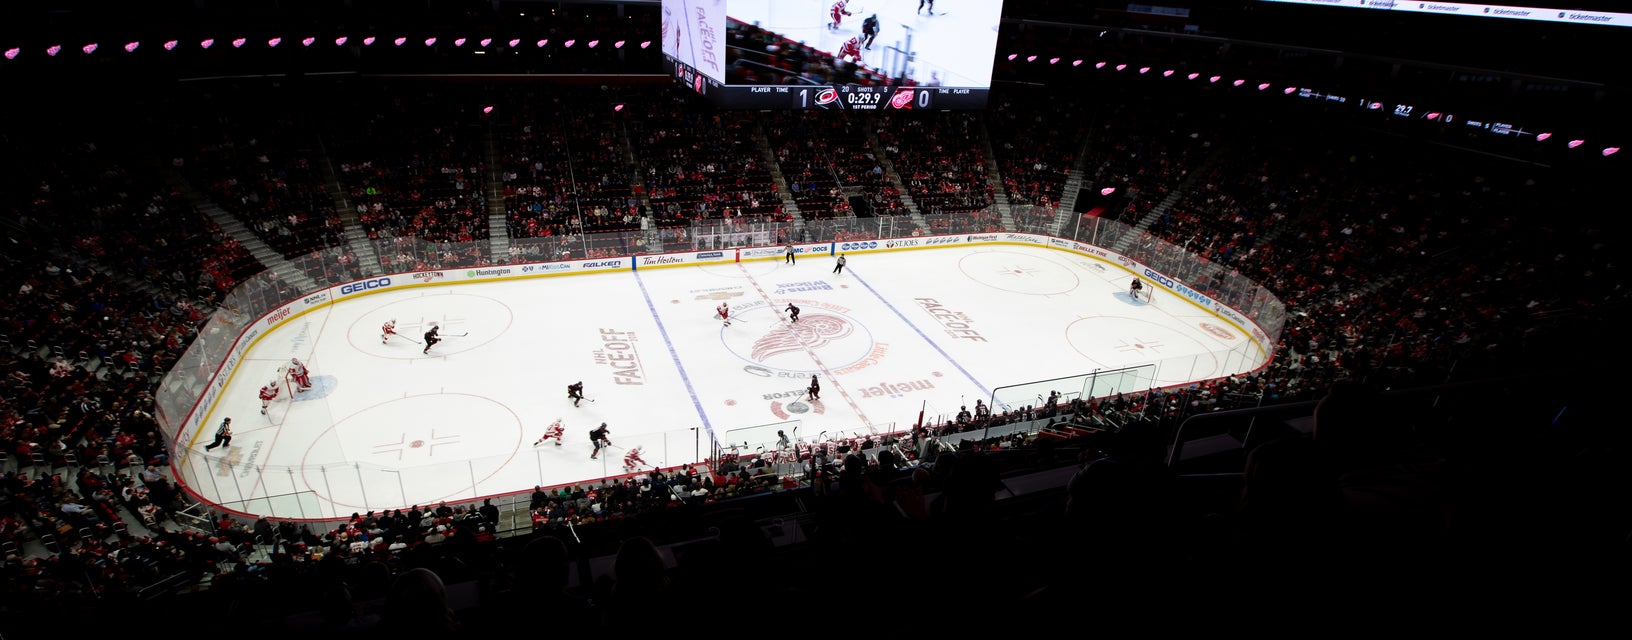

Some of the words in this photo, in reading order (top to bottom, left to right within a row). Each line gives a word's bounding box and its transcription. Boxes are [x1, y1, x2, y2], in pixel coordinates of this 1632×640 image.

[1427, 4, 1460, 12] ticketmaster
[1493, 8, 1531, 17] ticketmaster
[1569, 12, 1612, 23] ticketmaster
[799, 89, 808, 108] 1
[847, 92, 881, 104] 0:29.9
[918, 90, 930, 108] 0
[1395, 103, 1414, 114] 29.7
[1078, 245, 1094, 254] BELLE
[643, 256, 656, 265] Tim
[656, 256, 684, 264] Hortons
[412, 271, 444, 280] HOCKEYTOWN
[476, 267, 511, 278] Huntington
[1144, 268, 1174, 289] GEICO
[340, 277, 391, 296] GEICO
[267, 306, 291, 326] meijer
[914, 297, 988, 342] FACE-OFF
[592, 348, 608, 365] NHL
[599, 328, 644, 386] FACE-OFF
[762, 387, 807, 401] ELFOR
[858, 379, 936, 399] meijer
